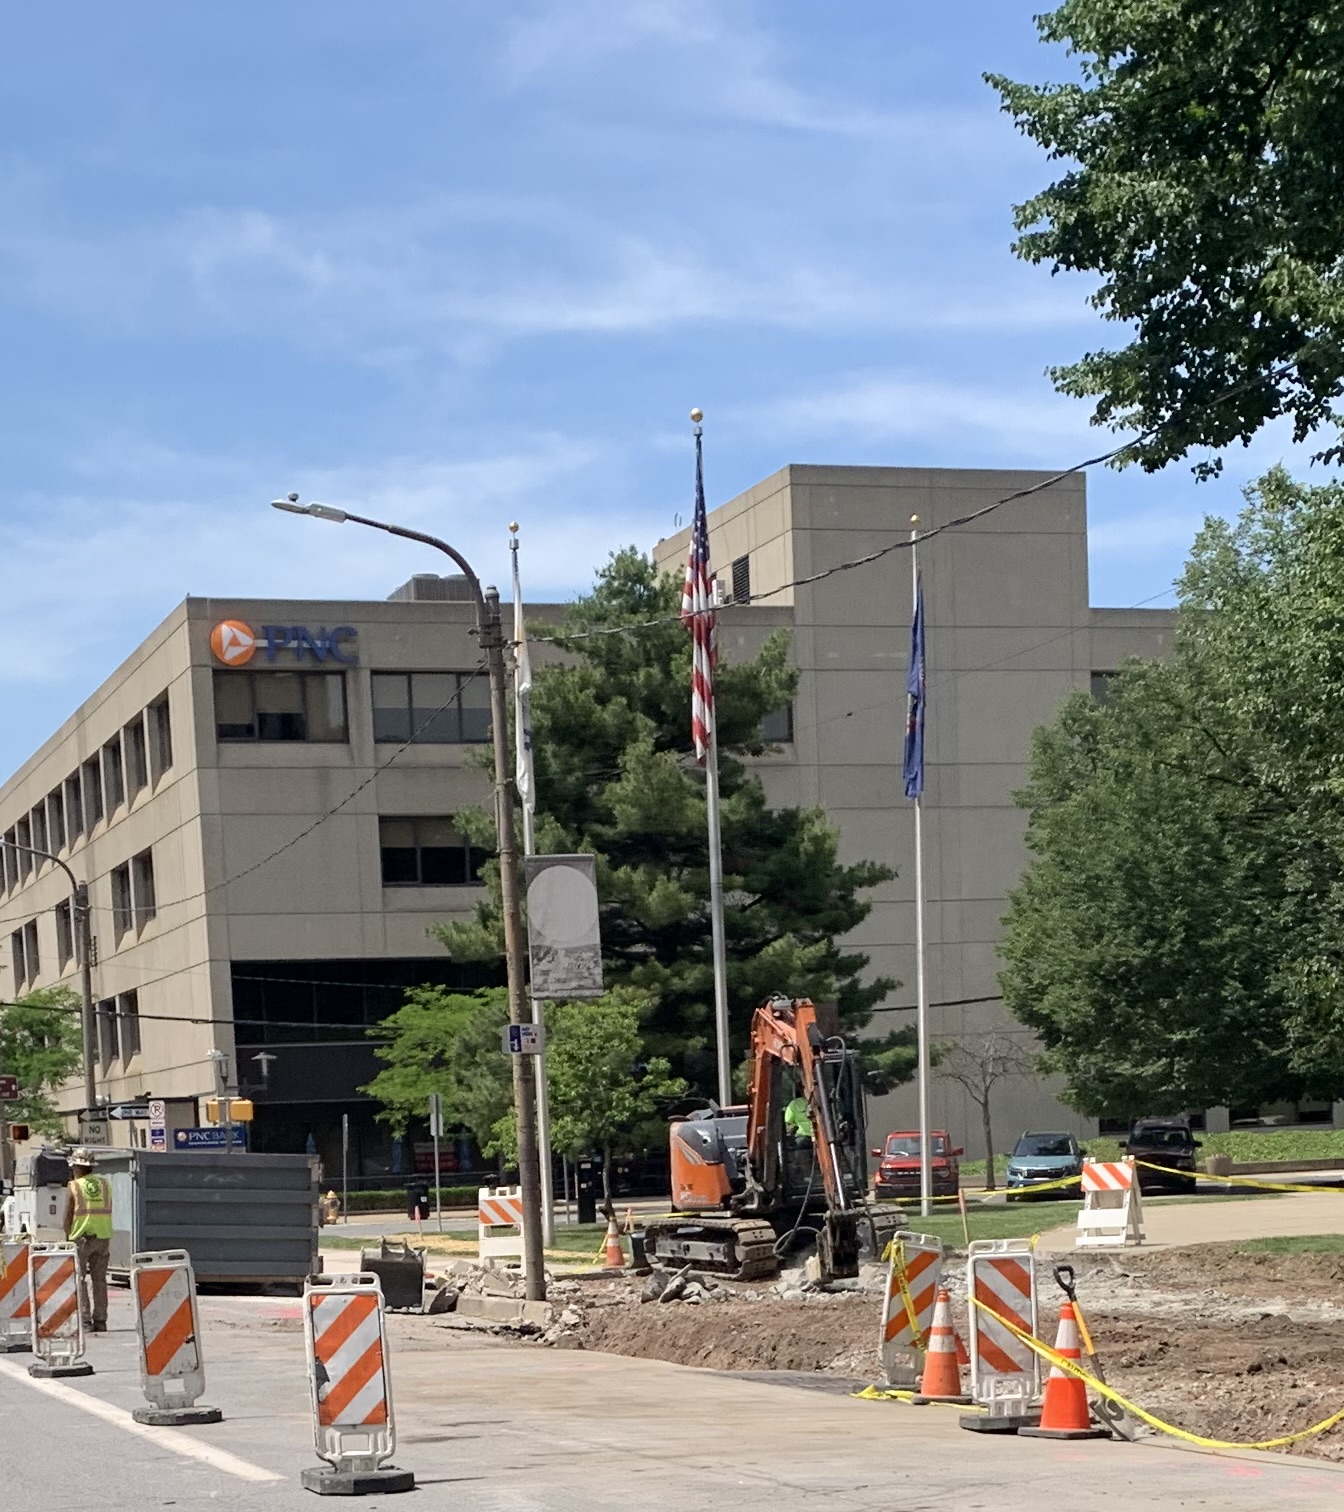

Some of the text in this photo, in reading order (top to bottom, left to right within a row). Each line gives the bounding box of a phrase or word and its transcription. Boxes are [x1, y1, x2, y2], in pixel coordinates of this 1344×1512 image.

[262, 625, 359, 665] PNC
[89, 1124, 101, 1134] NO
[188, 1130, 240, 1141] PNC BAK
